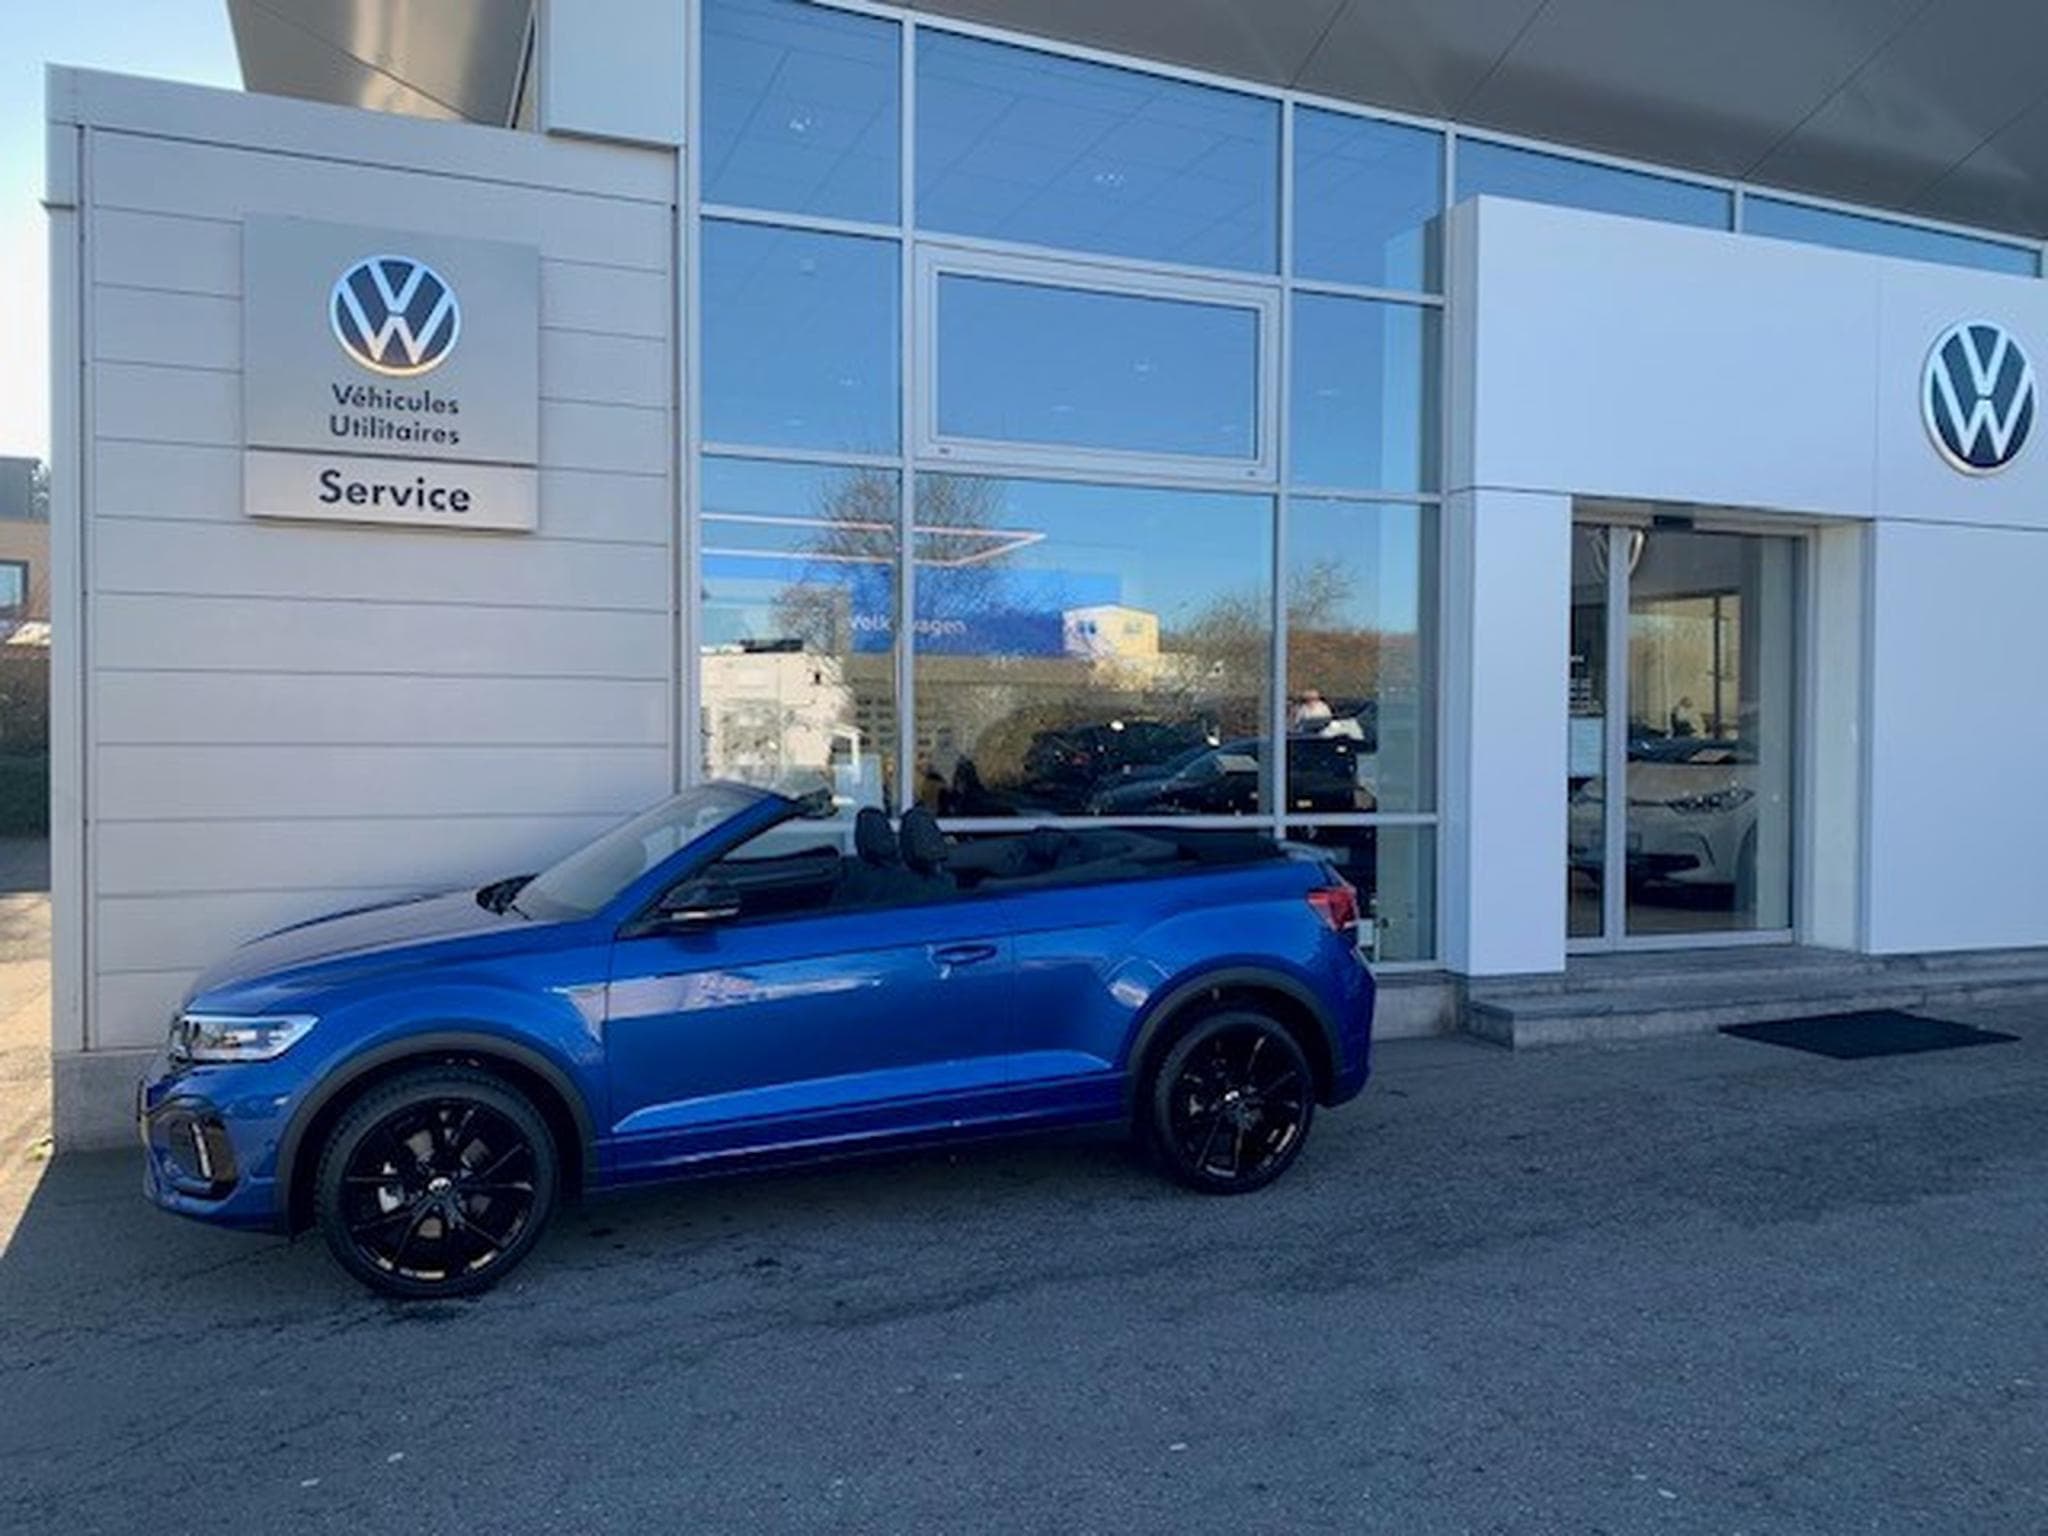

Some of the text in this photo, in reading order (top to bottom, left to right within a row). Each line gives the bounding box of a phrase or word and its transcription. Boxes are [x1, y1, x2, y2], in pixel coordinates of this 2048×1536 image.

[331, 255, 459, 370] VW
[332, 383, 459, 414] Véhicules
[1925, 322, 2035, 466] VW
[330, 415, 460, 444] Utilitaires
[319, 469, 470, 512] Service
[849, 614, 967, 637] Volkagen
